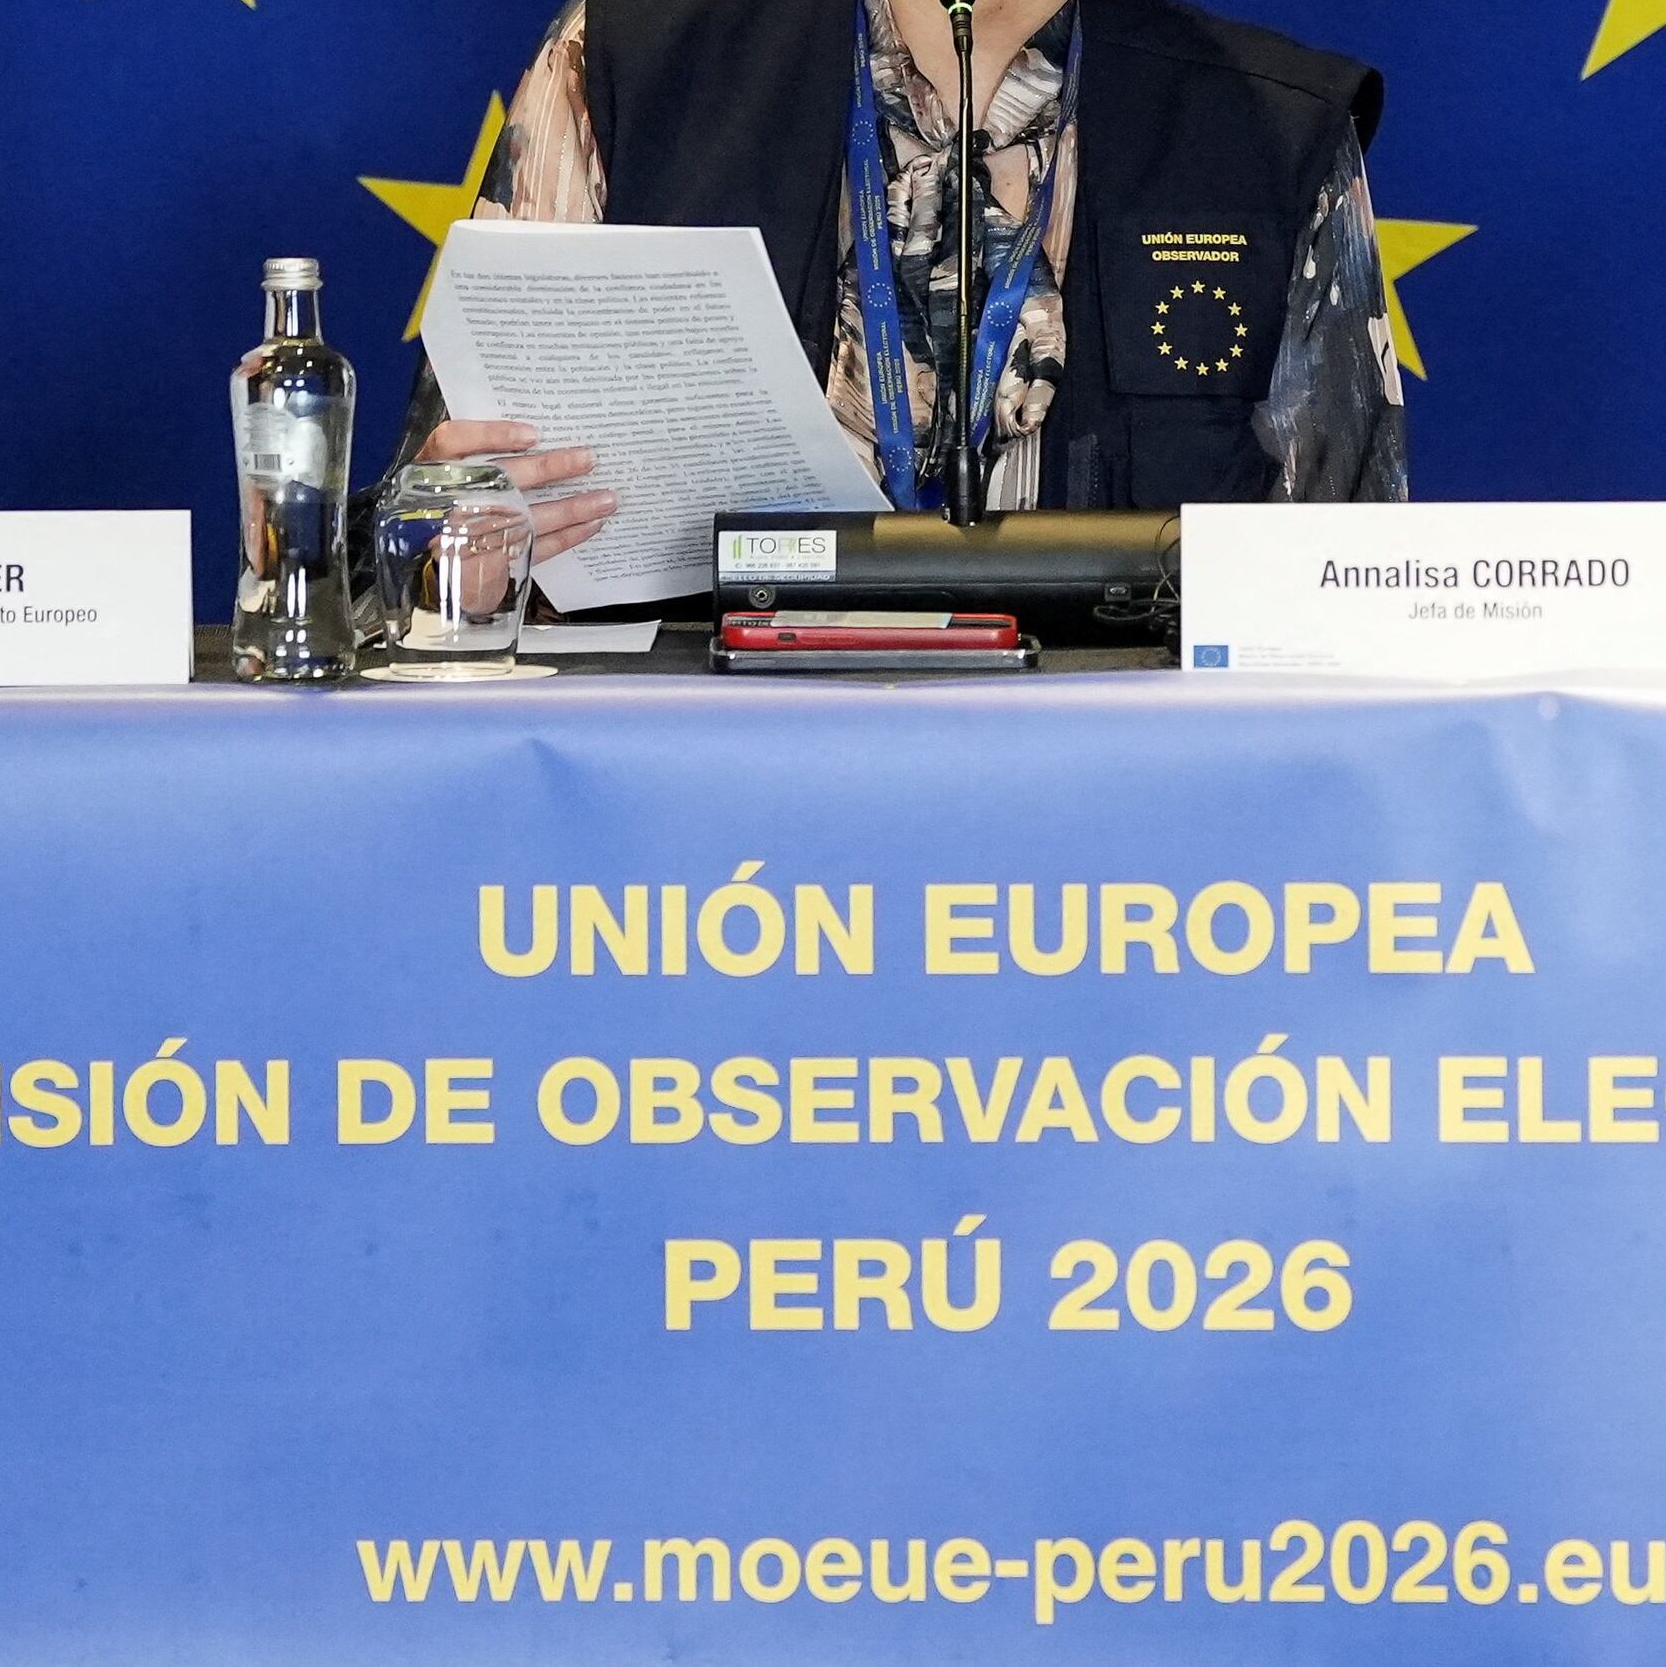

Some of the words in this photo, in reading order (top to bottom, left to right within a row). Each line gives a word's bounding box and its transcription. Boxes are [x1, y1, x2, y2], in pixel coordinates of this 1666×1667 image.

[1142, 231, 1183, 245] UNIÓN
[1186, 233, 1248, 246] EUROPEA
[1151, 250, 1240, 262] OBSERVADOR
[1320, 559, 1458, 588] Annalisa
[1473, 558, 1629, 588] CORRADO
[23, 606, 98, 627] Europeo
[1408, 602, 1447, 620] Jefa
[1454, 602, 1475, 619] de
[1483, 602, 1542, 619] Misión
[480, 860, 873, 977] UNIÓN
[926, 882, 1534, 974] EUROPEA
[339, 1059, 495, 1143] DE
[539, 1035, 1390, 1144] OBSERVACIÓN
[666, 1215, 1001, 1330] PERÚ
[1050, 1241, 1351, 1330] 2026
[359, 1521, 1666, 1623] www.moeue-peru2026.eu
